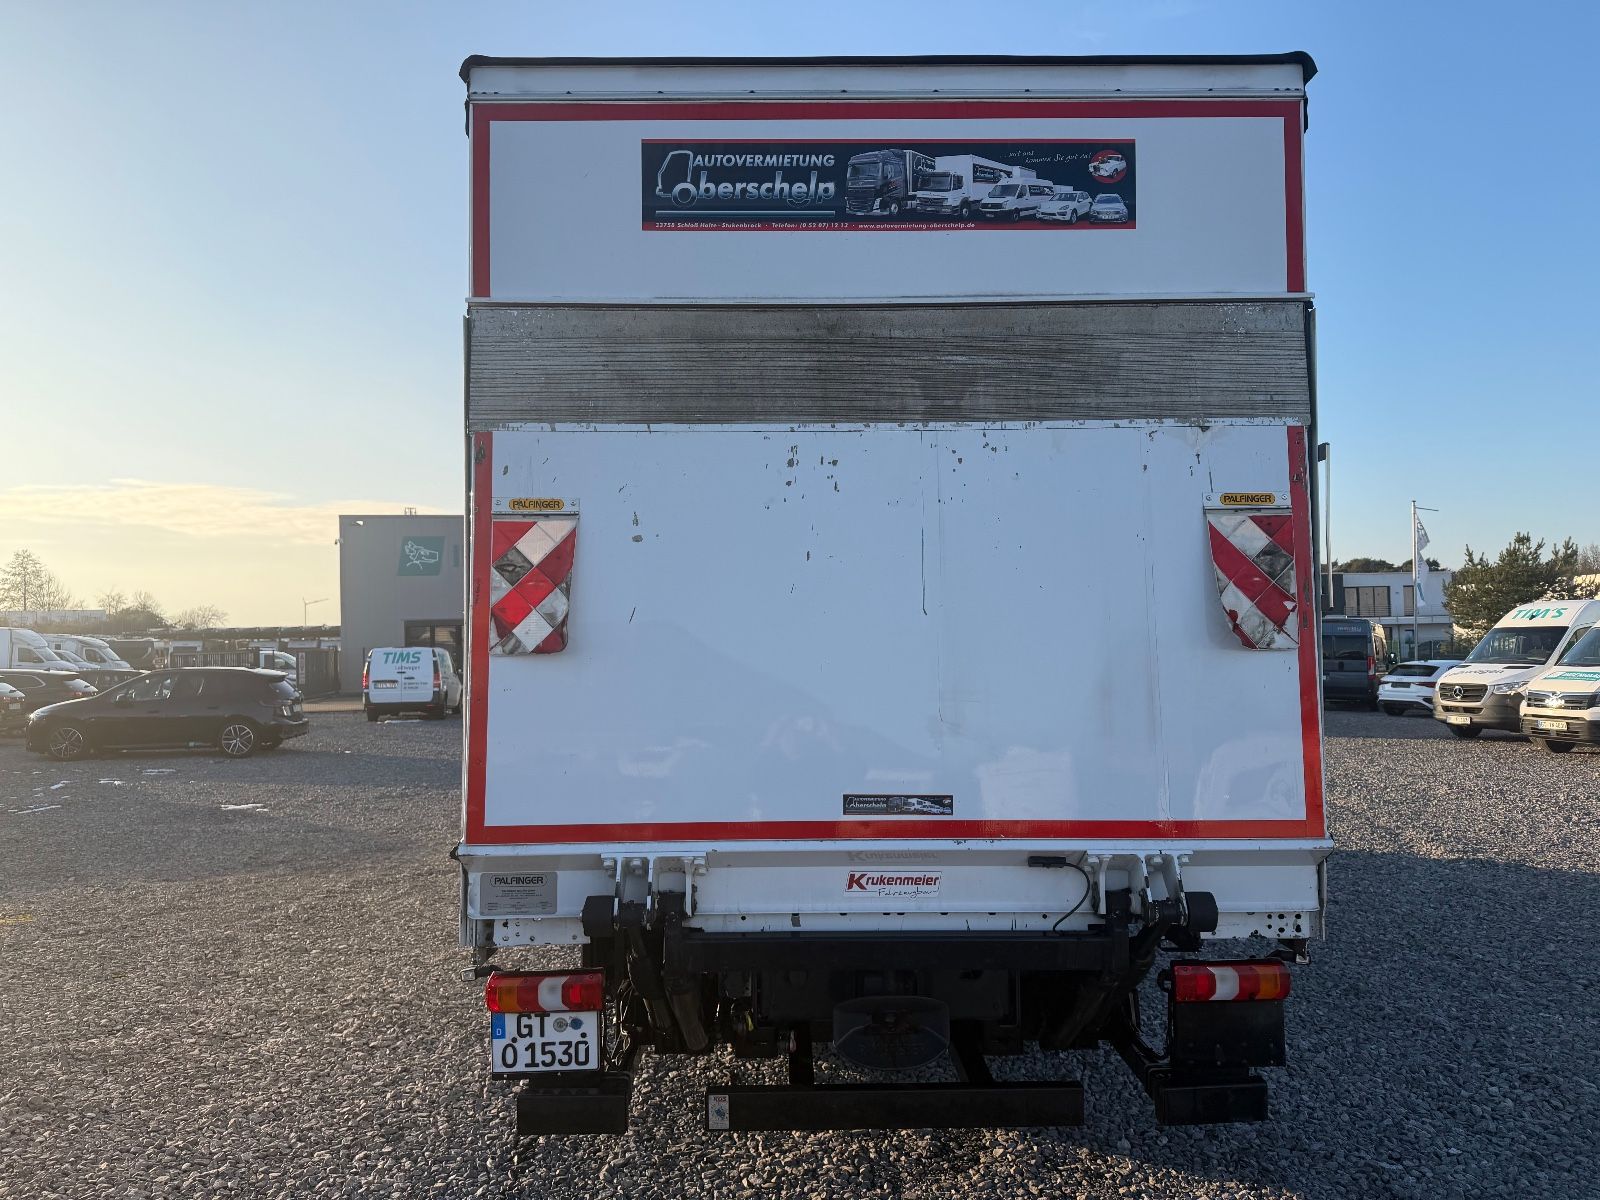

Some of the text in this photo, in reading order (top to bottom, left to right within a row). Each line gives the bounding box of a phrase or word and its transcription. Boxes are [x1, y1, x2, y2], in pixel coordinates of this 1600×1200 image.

[692, 154, 835, 167] AUTOVERMIETUNG
[672, 171, 835, 206] Oberschelp
[512, 500, 560, 509] PALFINGER
[1223, 494, 1272, 503] PALFINGER
[494, 876, 544, 885] PALFINGER
[847, 873, 939, 890] Krukenmeier
[516, 1012, 551, 1038] GT
[524, 1040, 590, 1068] 1530
